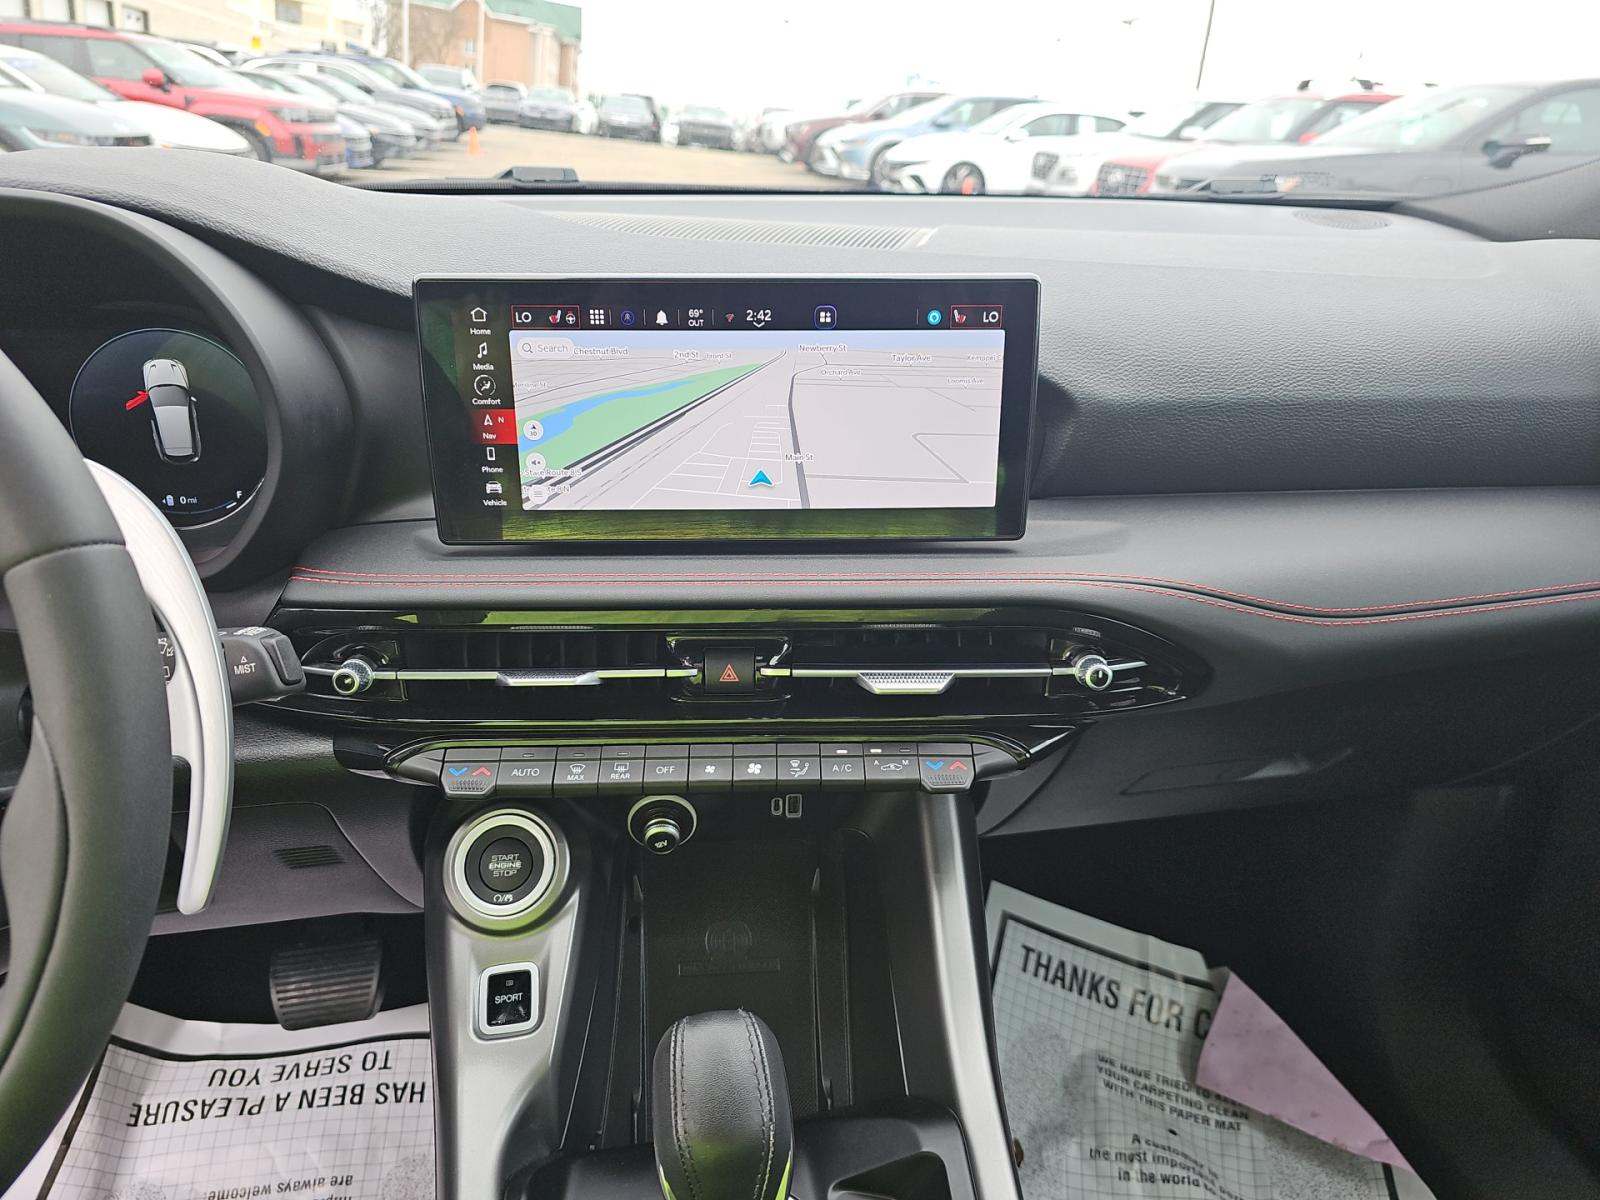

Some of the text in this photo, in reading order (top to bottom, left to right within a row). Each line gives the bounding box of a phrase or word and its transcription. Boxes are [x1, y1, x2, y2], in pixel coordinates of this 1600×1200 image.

[515, 311, 532, 323] LO
[746, 309, 772, 321] 2:42
[982, 311, 999, 322] LO
[688, 319, 704, 327] OUT
[537, 343, 568, 353] Search
[573, 347, 629, 355] Chestnut Blvd
[799, 344, 847, 353] Newberry St
[892, 354, 915, 362] Taylor
[472, 363, 495, 371] Media
[472, 398, 501, 406] Comfort
[498, 416, 505, 424] N
[482, 432, 497, 440] Nav
[805, 453, 814, 461] St
[236, 490, 243, 499] F
[179, 496, 187, 504] 0
[233, 662, 256, 675] MIST
[510, 767, 540, 777] AUTO
[655, 765, 675, 775] OFF
[832, 763, 853, 773] A/C
[566, 773, 585, 781] MAX
[610, 772, 631, 780] REAR
[491, 854, 520, 862] START
[488, 861, 522, 870] ENGINE
[492, 869, 518, 877] STOP
[1021, 944, 1121, 1009] THANKS
[1128, 988, 1184, 1032] FOR
[494, 992, 524, 1004] SPORT
[207, 1050, 393, 1087] TO SERVE YOU
[1120, 1063, 1151, 1080] HAVE
[1155, 1072, 1190, 1092] TRIED
[1096, 1065, 1129, 1085] YOUR
[1133, 1079, 1203, 1111] CARPETING
[1207, 1102, 1249, 1120] CLEAN
[126, 1081, 427, 1127] HAS BEEN A PLEASURE
[1103, 1079, 1241, 1131] WITH THIS PAPER MAT
[1131, 1133, 1141, 1144] A
[1089, 1147, 1111, 1161] the
[1114, 1150, 1148, 1163] most
[330, 1174, 354, 1187] are
[1118, 1167, 1131, 1181] in
[1160, 1173, 1201, 1187] world
[276, 1177, 326, 1194] always
